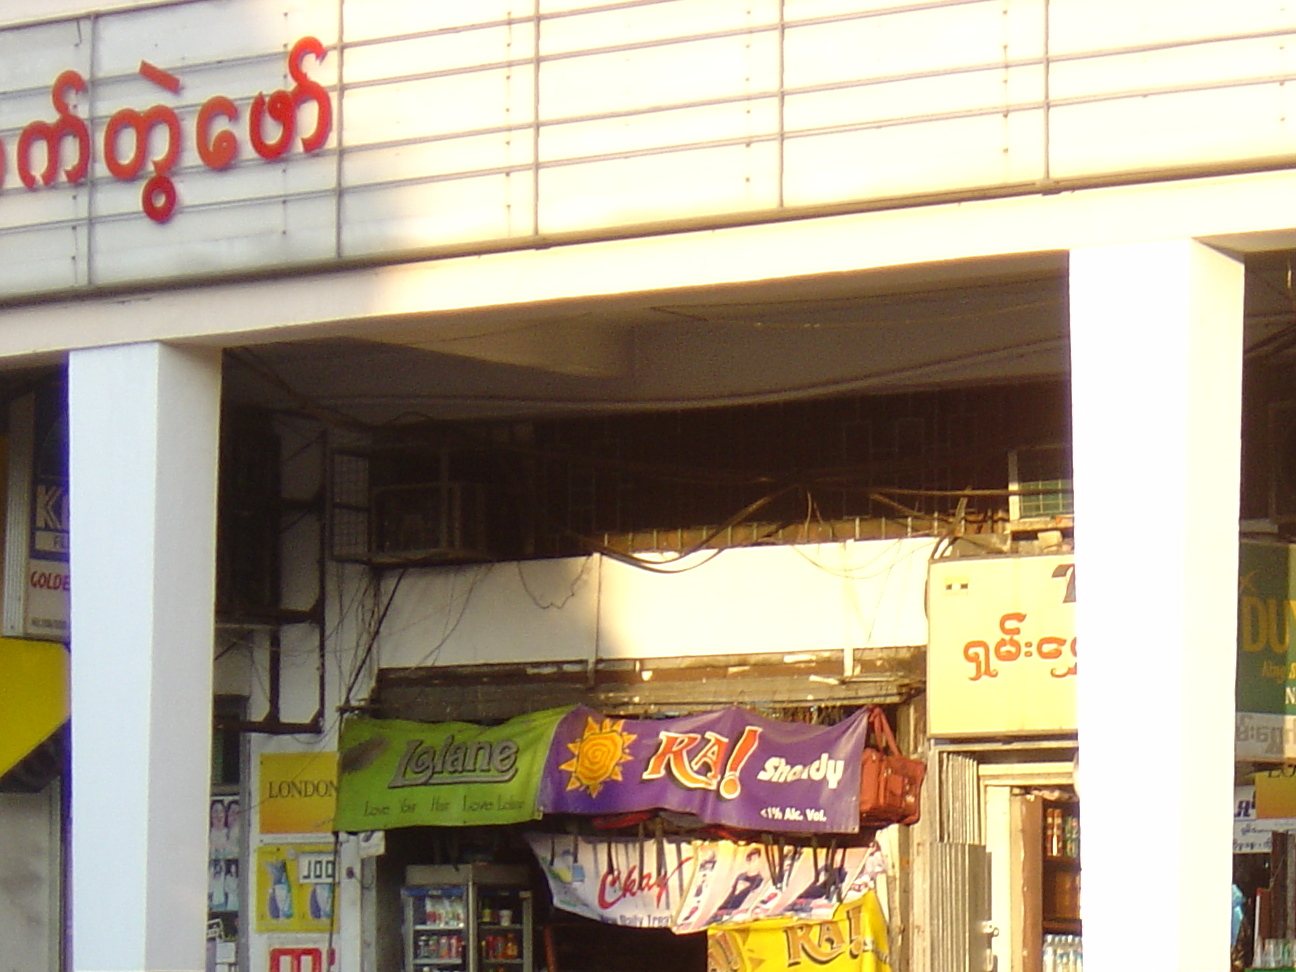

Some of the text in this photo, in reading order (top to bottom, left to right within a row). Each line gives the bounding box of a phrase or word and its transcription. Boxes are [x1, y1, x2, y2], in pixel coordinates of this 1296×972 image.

[642, 726, 763, 799] RA!
[268, 780, 338, 798] LONDON
[784, 808, 803, 821] Alc.
[805, 809, 827, 822] Vol.
